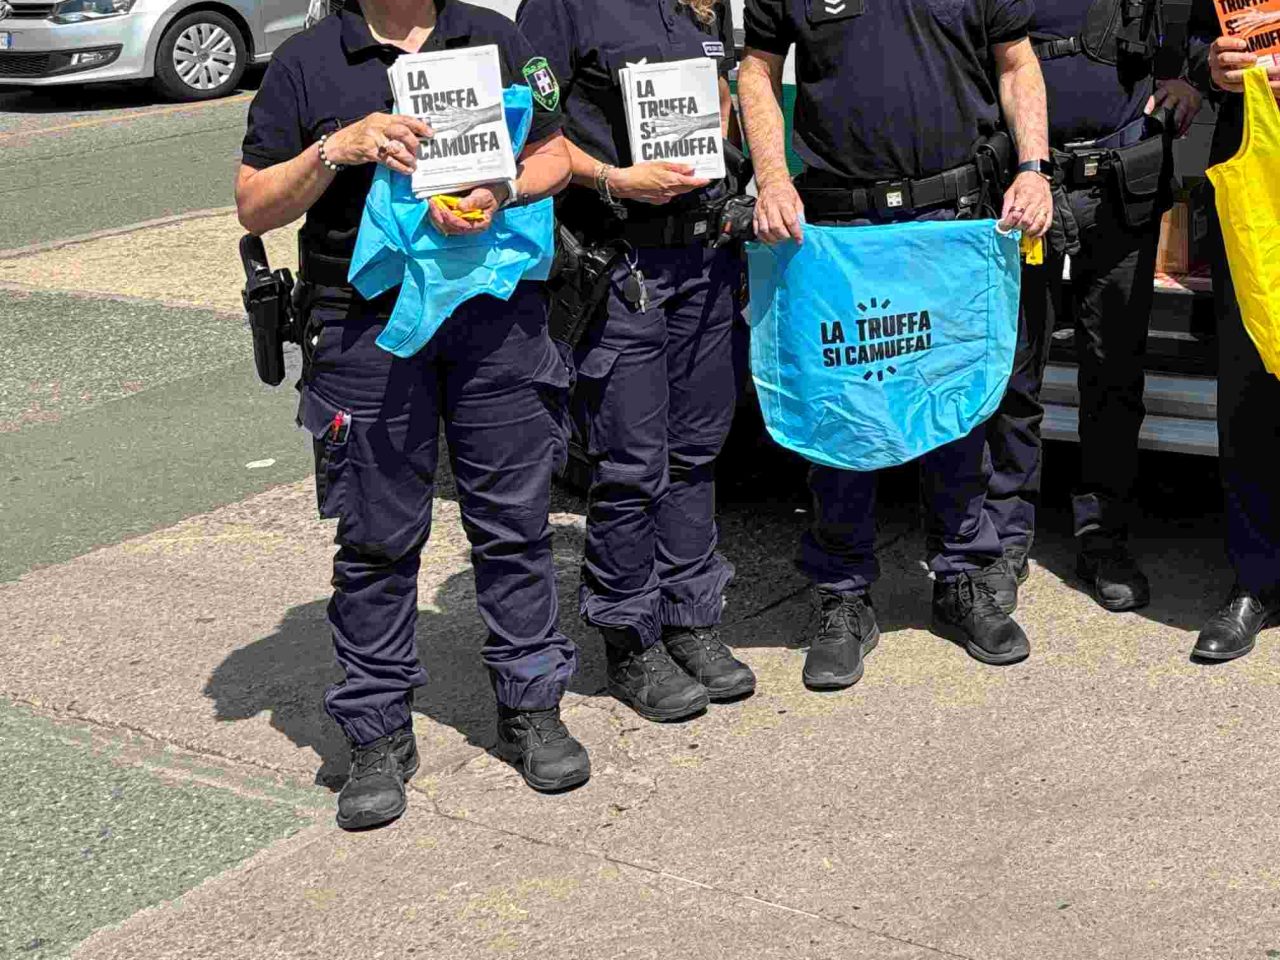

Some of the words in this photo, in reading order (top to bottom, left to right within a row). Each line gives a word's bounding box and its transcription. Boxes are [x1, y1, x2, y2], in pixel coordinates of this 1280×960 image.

[407, 69, 430, 91] LA
[636, 79, 656, 98] LA
[409, 87, 479, 115] TRUFFA
[638, 96, 699, 119] TRUFFA
[416, 130, 500, 161] CAMUFFA
[641, 136, 718, 161] CAMUFFA
[820, 320, 845, 344] LA
[855, 310, 932, 342] TRUFFA
[822, 347, 842, 367] SI
[844, 332, 932, 365] CAMUFFA!
